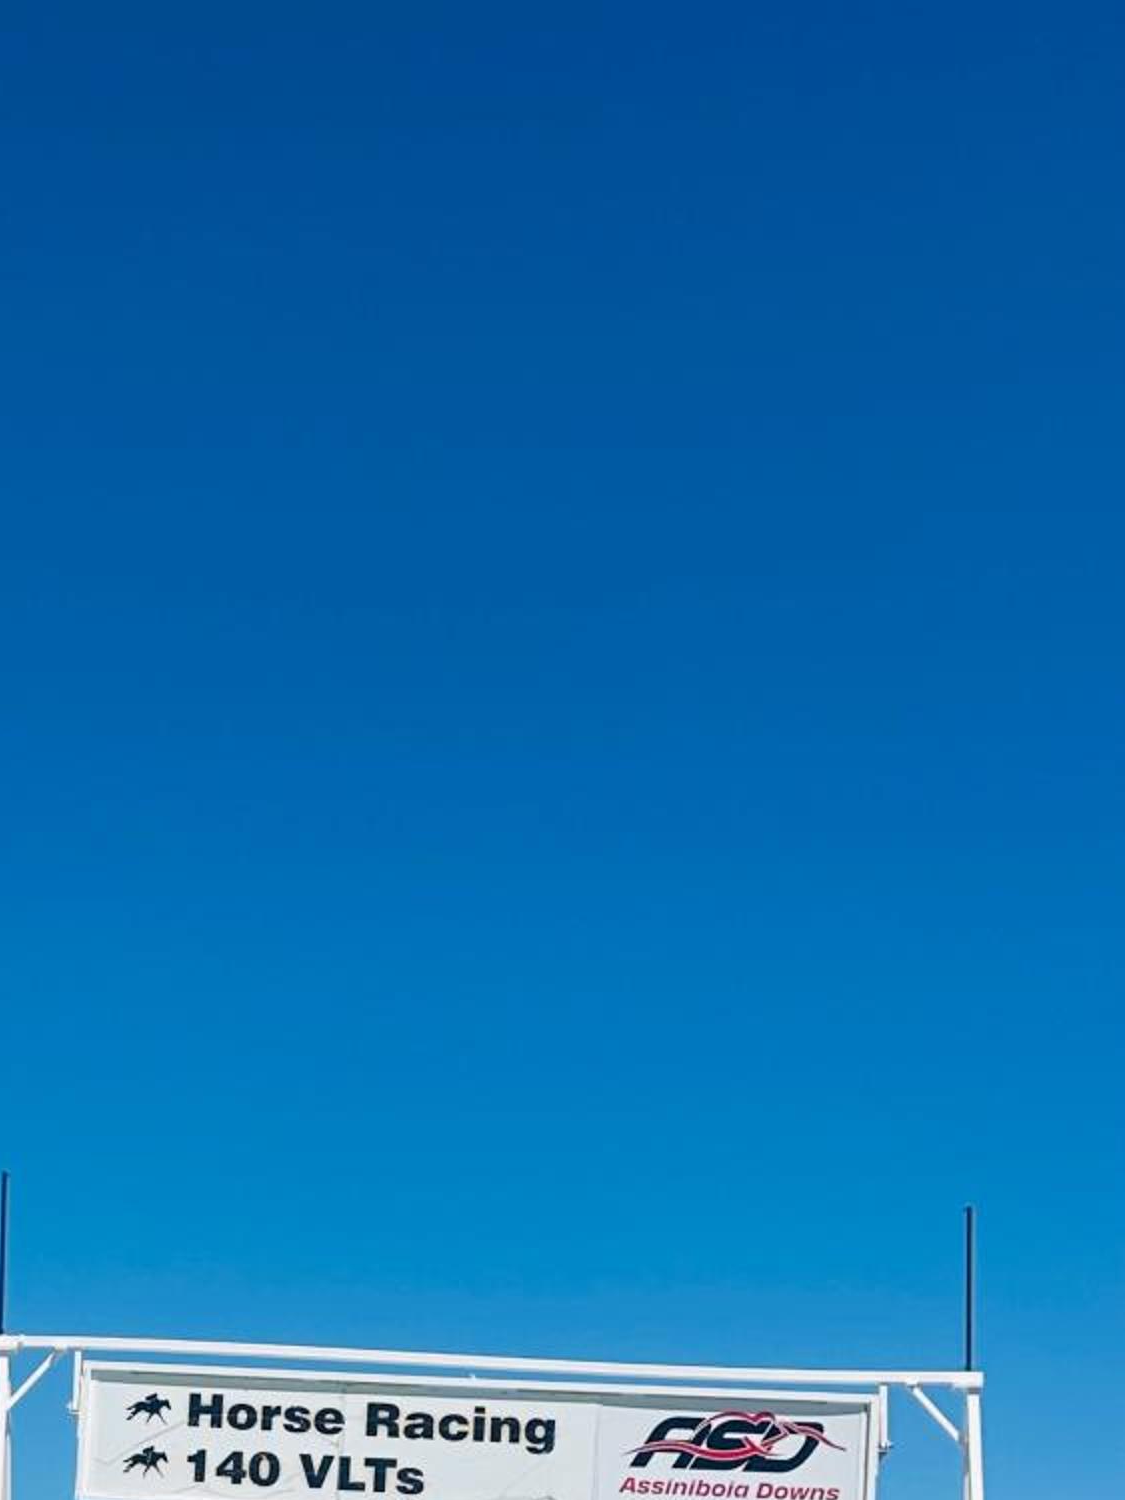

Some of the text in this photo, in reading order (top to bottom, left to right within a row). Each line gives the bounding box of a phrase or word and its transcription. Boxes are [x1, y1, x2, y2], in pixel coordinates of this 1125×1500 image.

[186, 1392, 557, 1455] Horse Racing
[186, 1448, 425, 1496] 140 VLTs
[618, 1476, 750, 1500] Assiniboia
